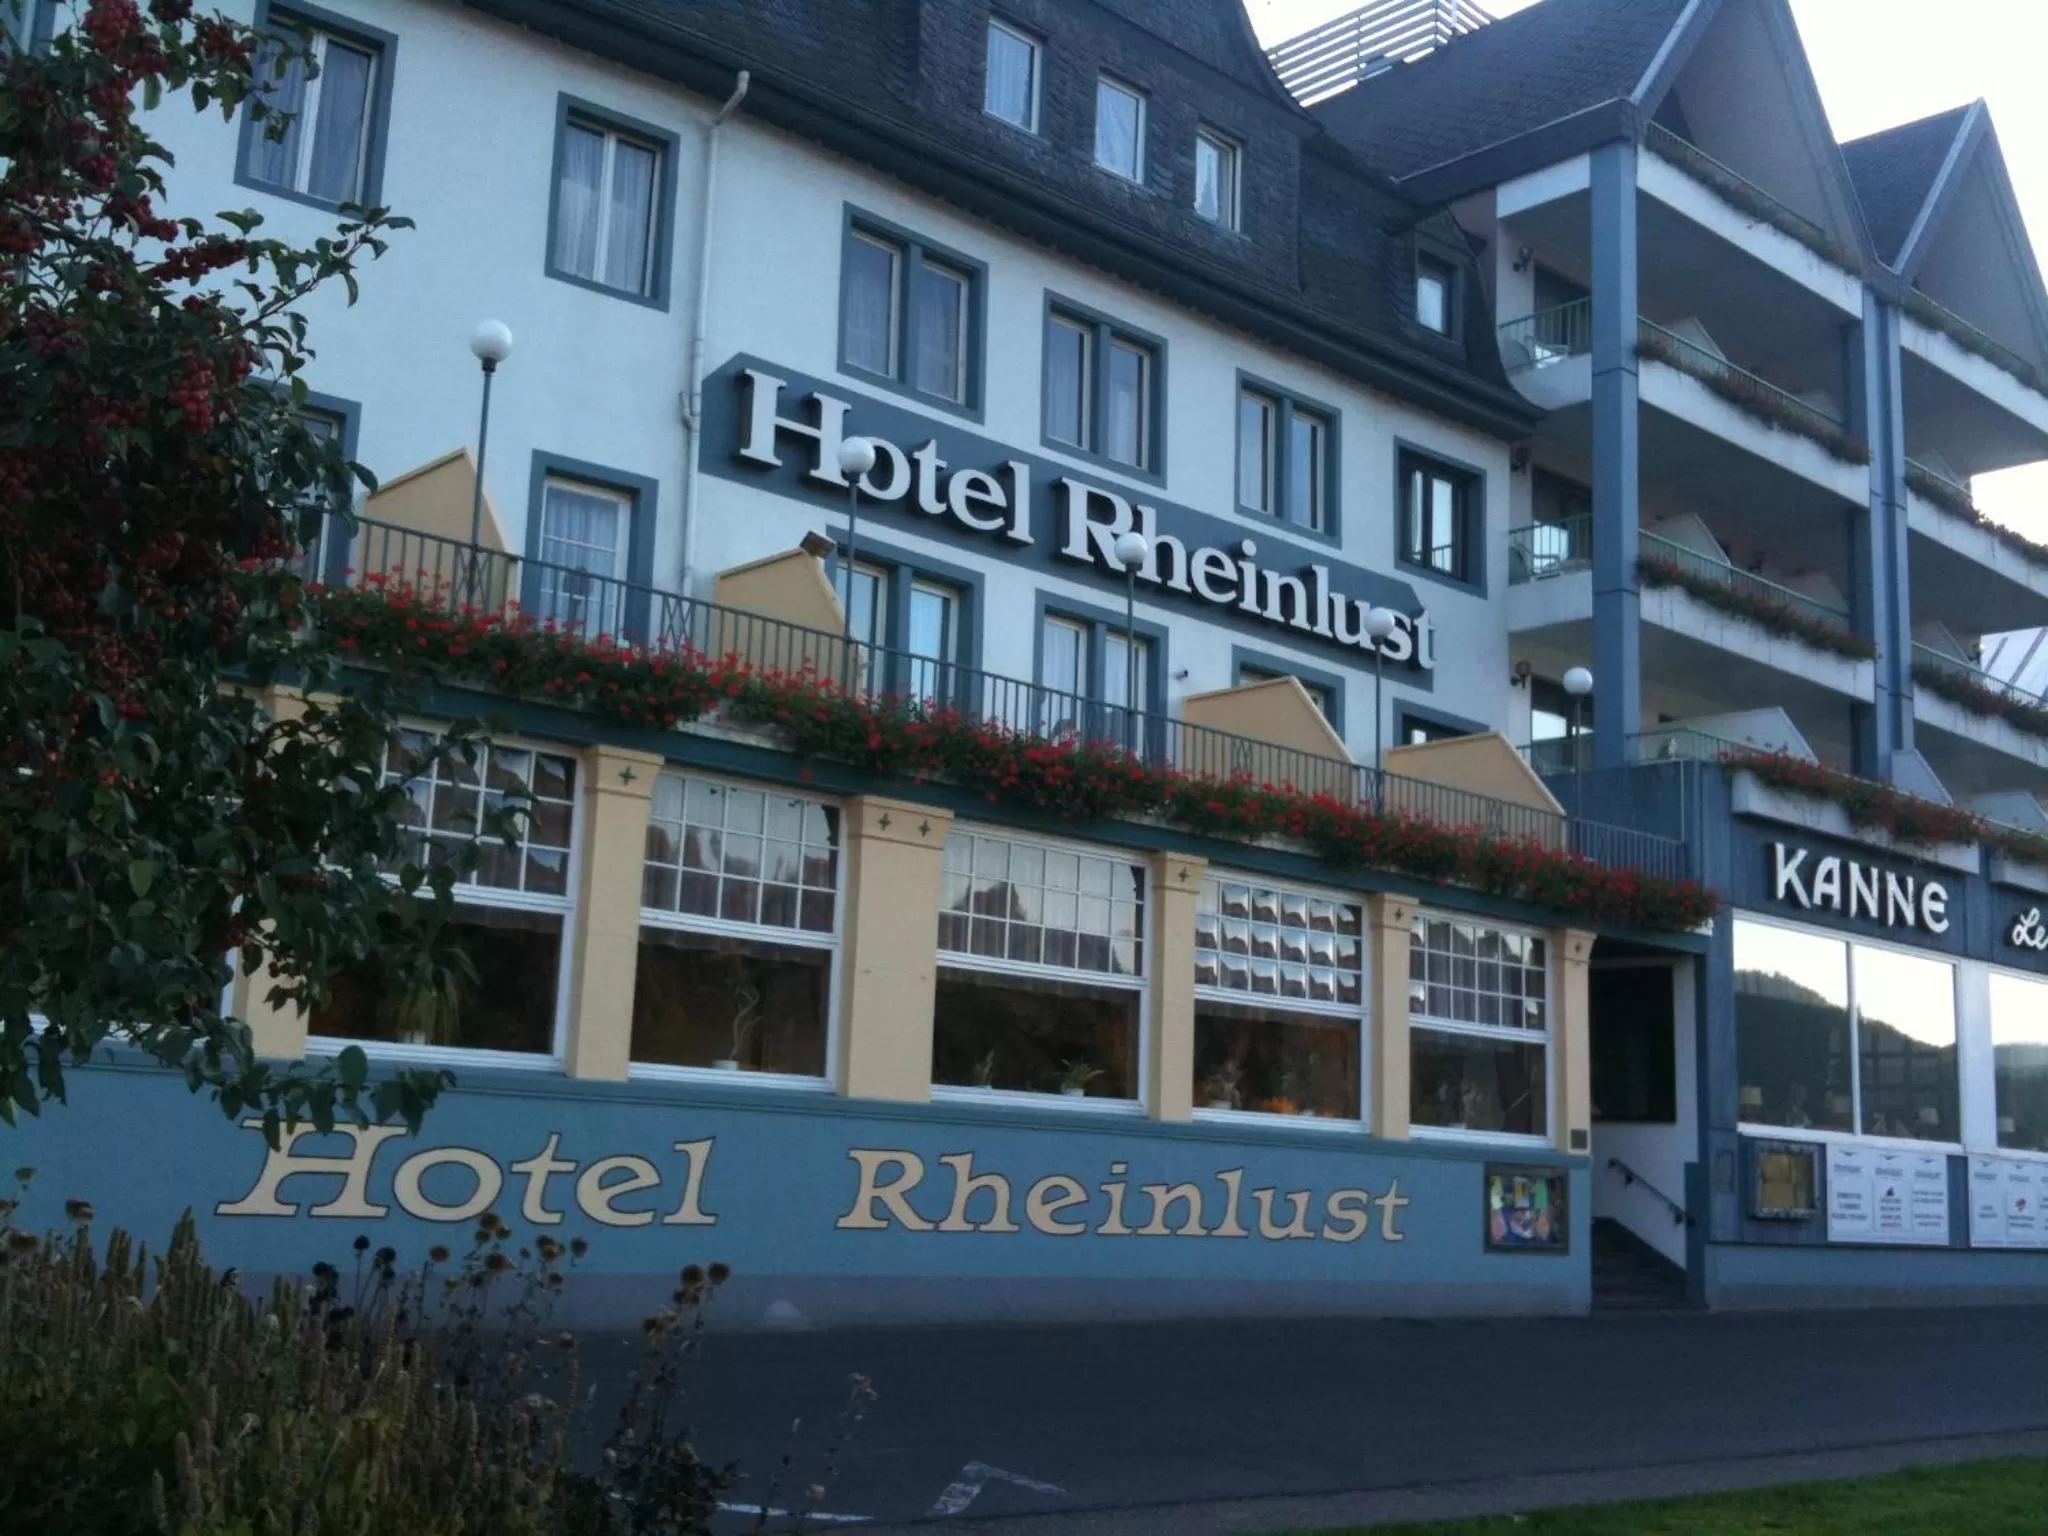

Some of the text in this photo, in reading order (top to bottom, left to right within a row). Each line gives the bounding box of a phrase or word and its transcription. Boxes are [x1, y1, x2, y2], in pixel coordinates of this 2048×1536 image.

[738, 369, 1435, 669] Hotel Rheinlust
[1773, 842, 1949, 933] KANNE
[214, 1118, 1410, 1242] Hotel Rheinlust
